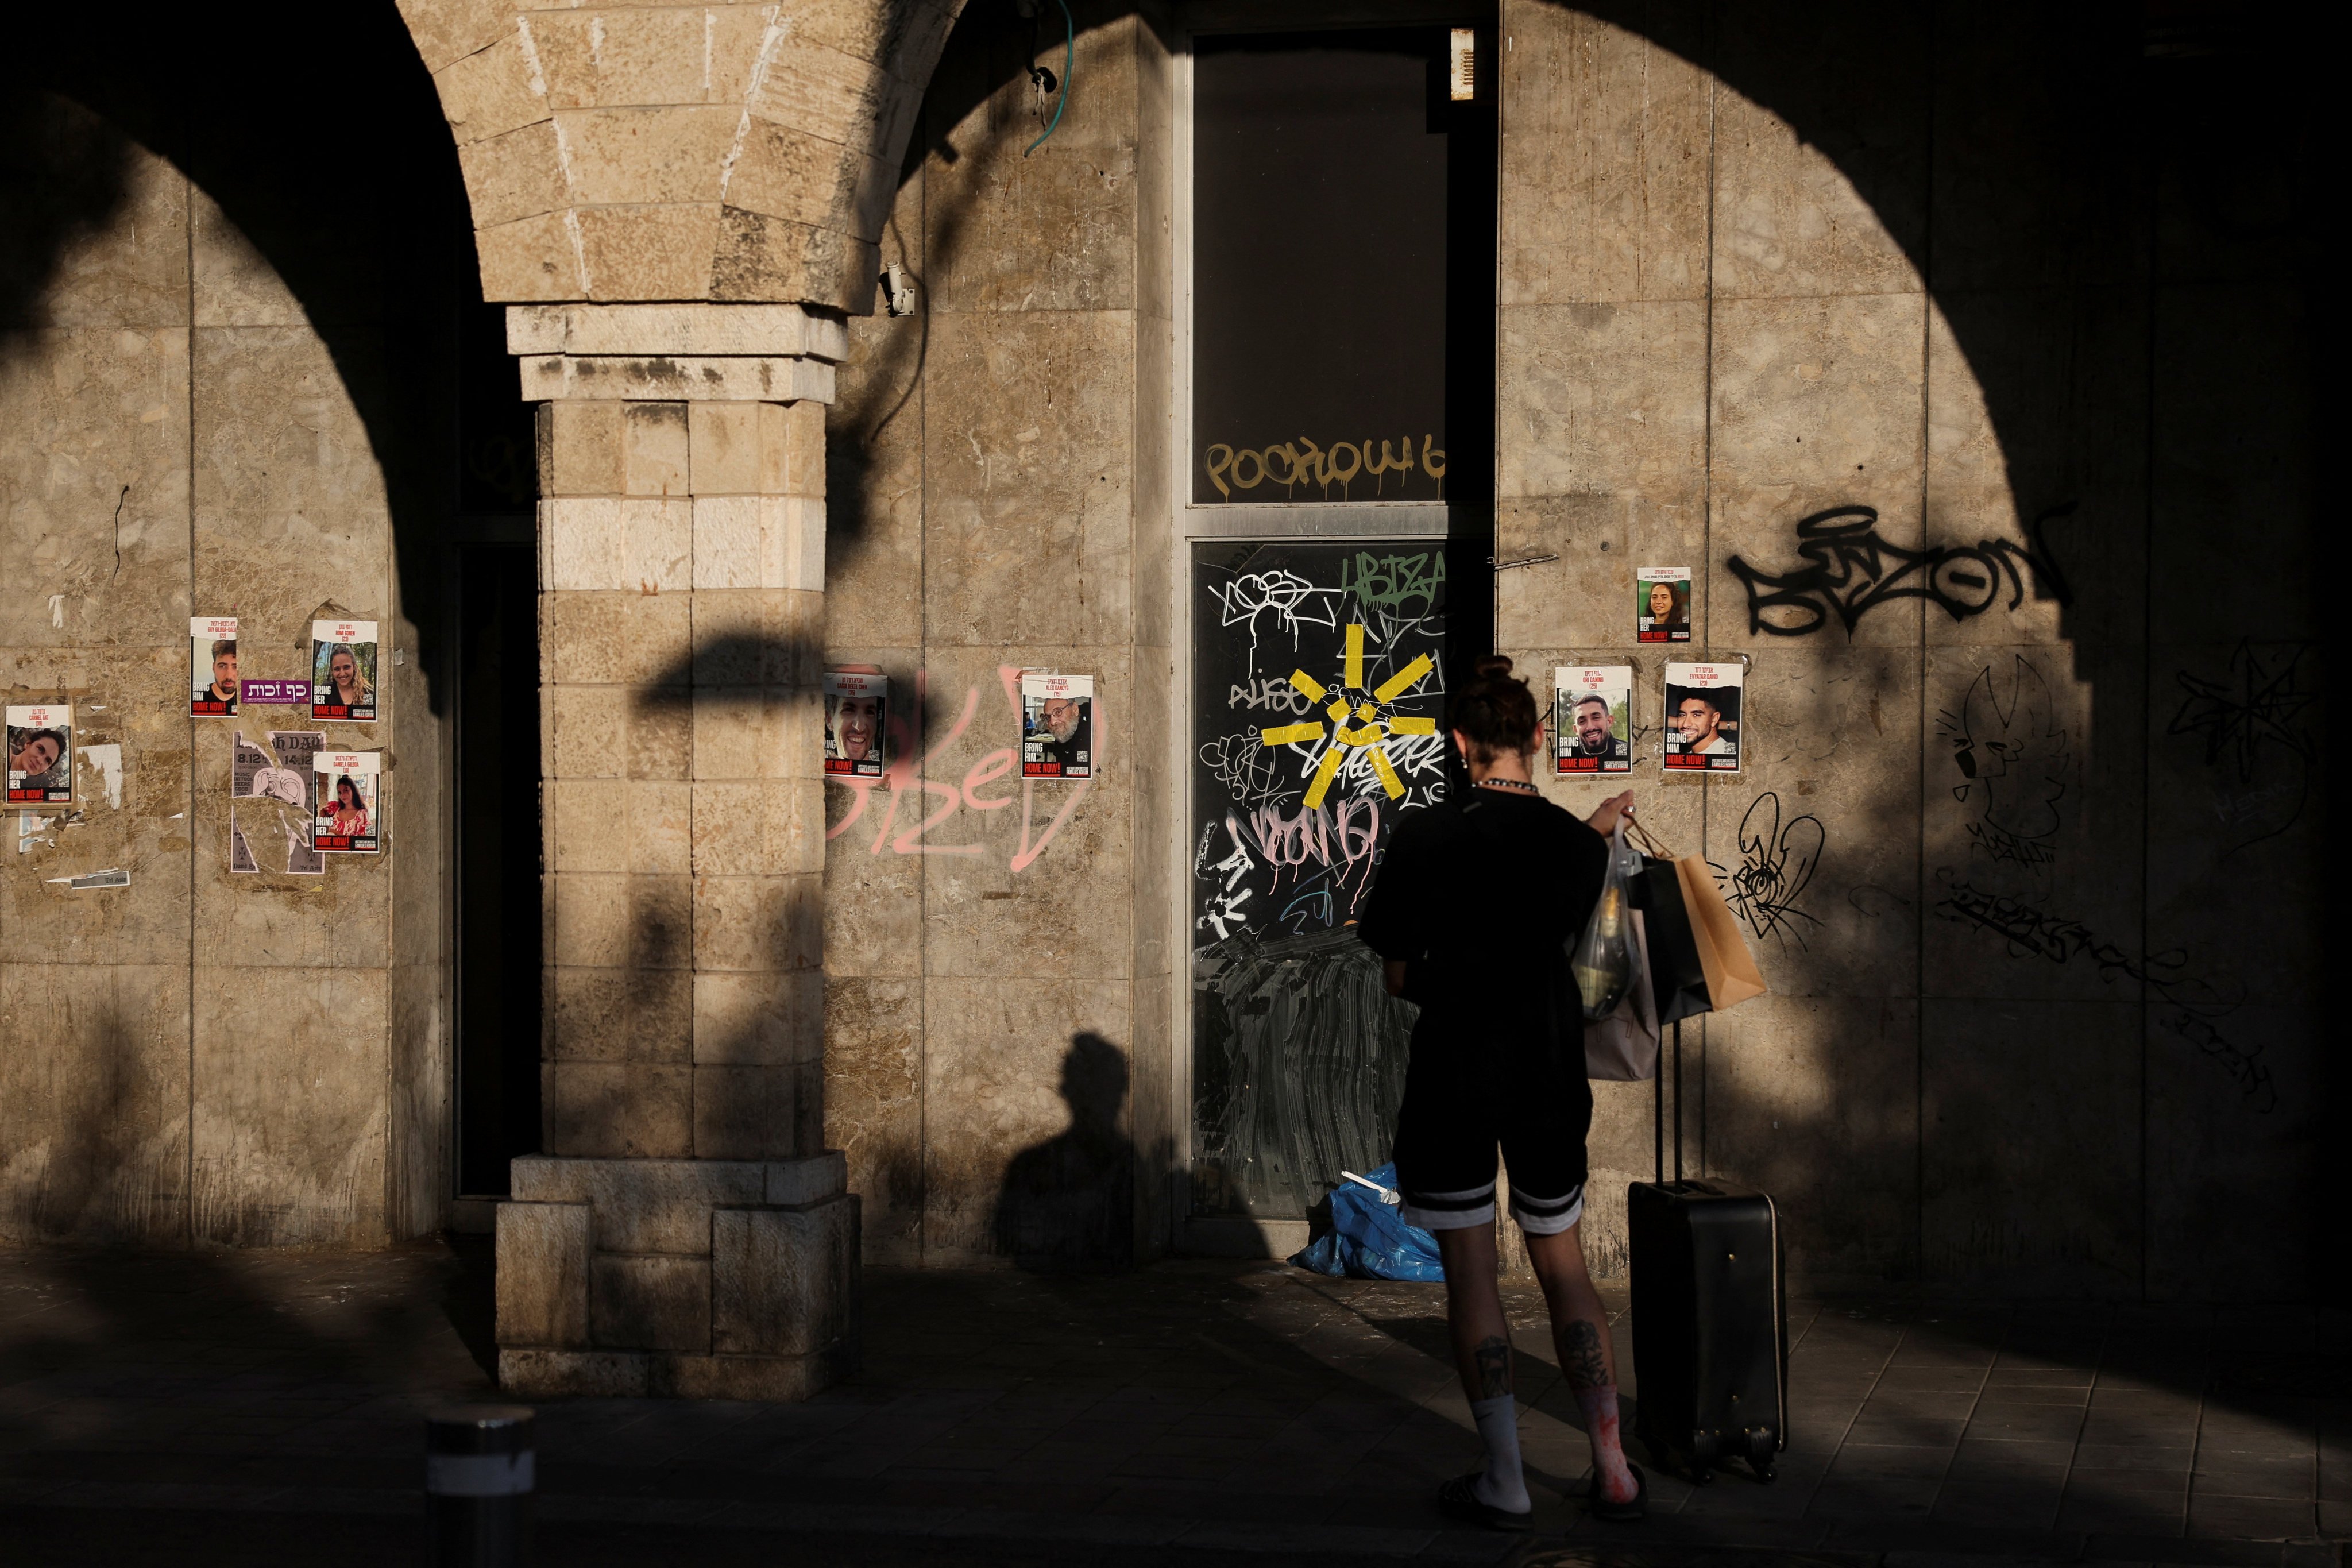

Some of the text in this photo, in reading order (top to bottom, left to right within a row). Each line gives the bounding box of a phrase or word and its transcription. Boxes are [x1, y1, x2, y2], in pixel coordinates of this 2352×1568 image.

[1640, 617, 1654, 625] BRING
[1654, 631, 1667, 639] NOW!
[193, 682, 210, 691] BRING
[314, 685, 331, 694] BRING
[193, 692, 203, 701] HIM
[248, 682, 306, 702] כף זכות
[314, 694, 325, 704] HER
[193, 702, 208, 711] HOME
[210, 701, 226, 711] NOW!
[314, 705, 347, 715] HOME NOW!
[1559, 737, 1579, 747] BRING
[1667, 733, 1687, 743] BRING
[1025, 743, 1043, 752] BRING
[1559, 747, 1571, 757] HIM
[1667, 743, 1679, 753] HIM
[238, 754, 260, 764] 8.12
[1025, 752, 1036, 762] HIM
[1666, 754, 1705, 764] HOME NOW!
[835, 760, 852, 770] NOW!
[1559, 757, 1598, 768] HOME NOW!
[1025, 763, 1060, 773] HOME NOW!
[9, 770, 26, 779] BRING
[9, 779, 21, 789] HER
[9, 789, 43, 799] HOME NOW!
[316, 817, 333, 826] BRING
[316, 827, 326, 836] HER
[316, 836, 350, 846] HOME NOW!
